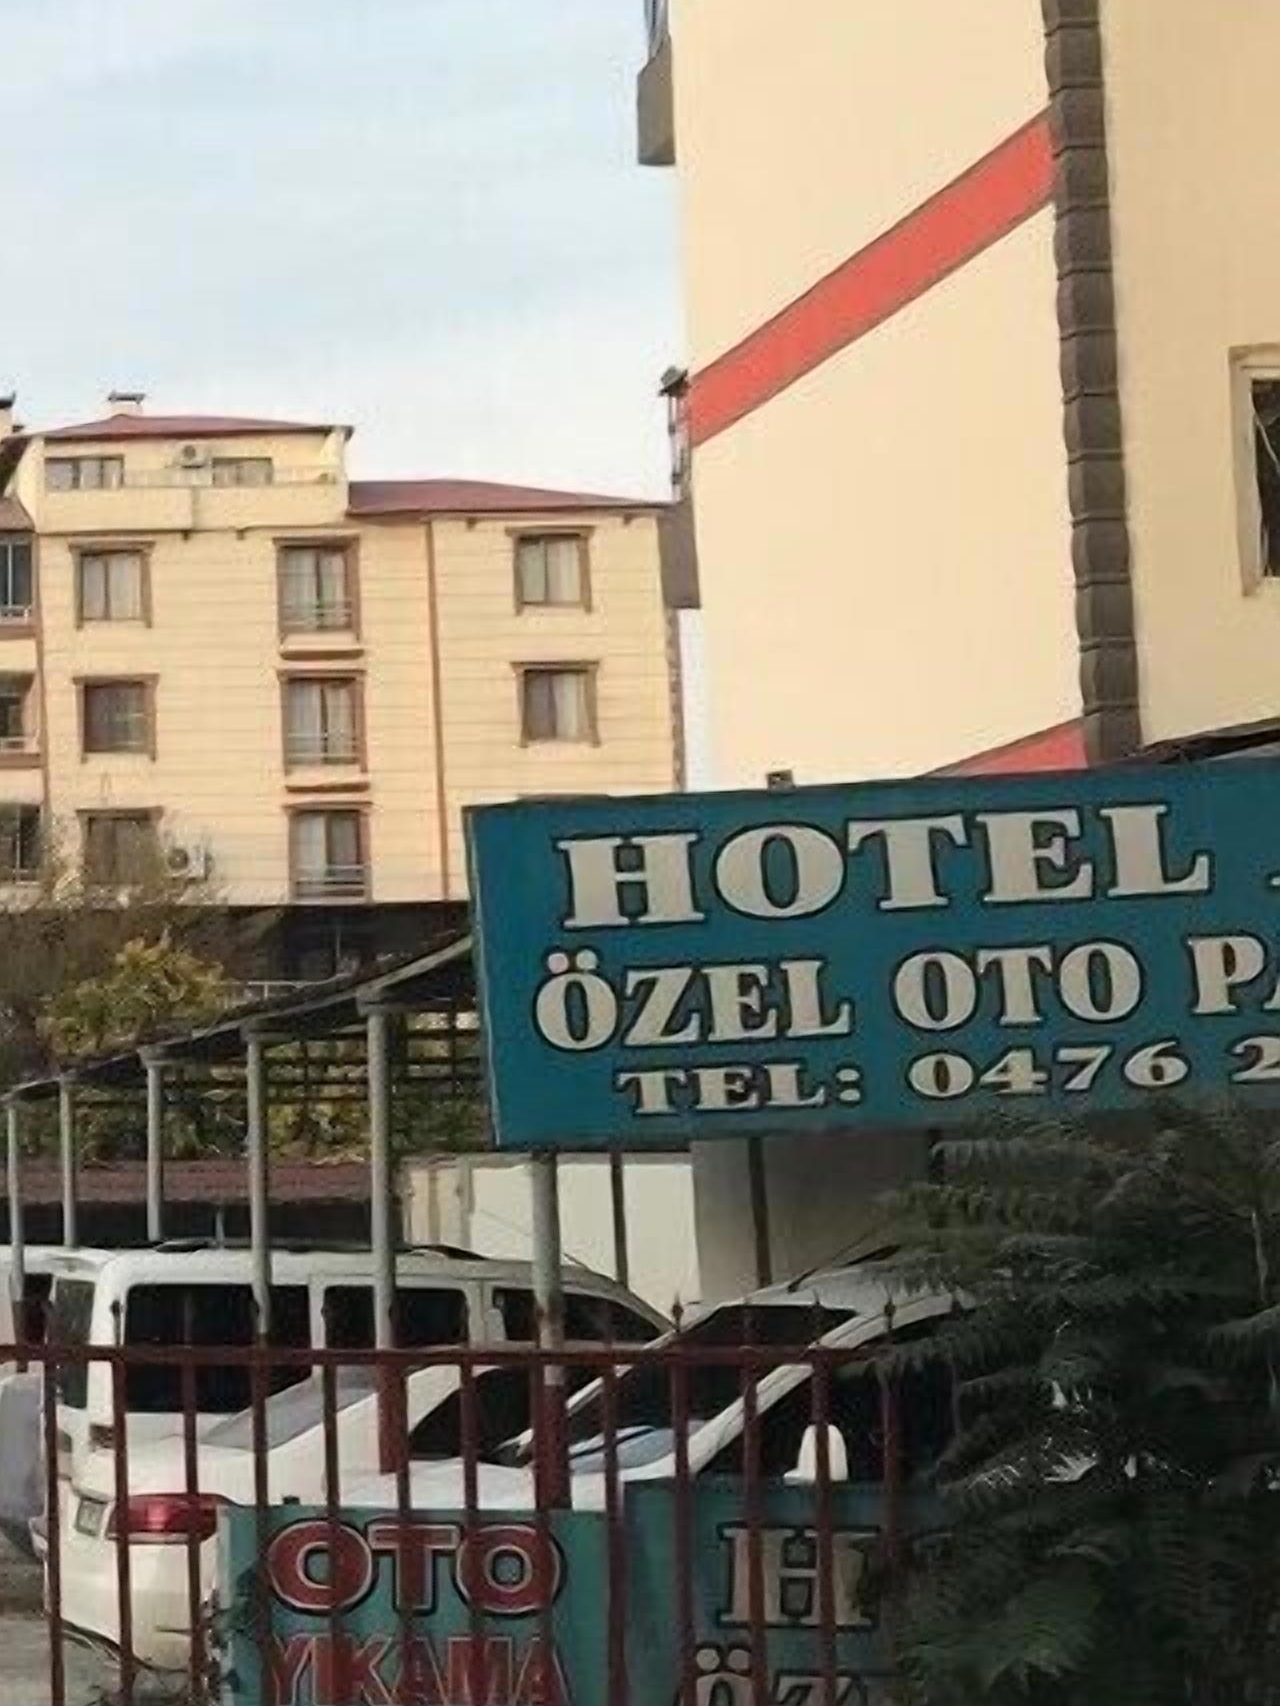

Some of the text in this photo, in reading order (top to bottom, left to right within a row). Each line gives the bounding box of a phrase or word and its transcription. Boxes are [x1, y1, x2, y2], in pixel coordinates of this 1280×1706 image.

[558, 802, 1211, 930] HOTEL
[534, 935, 1280, 1052] ÖZEL OTO P
[618, 1062, 861, 1115] TEL:
[907, 1041, 1190, 1098] 0476
[267, 1518, 562, 1616] OTO
